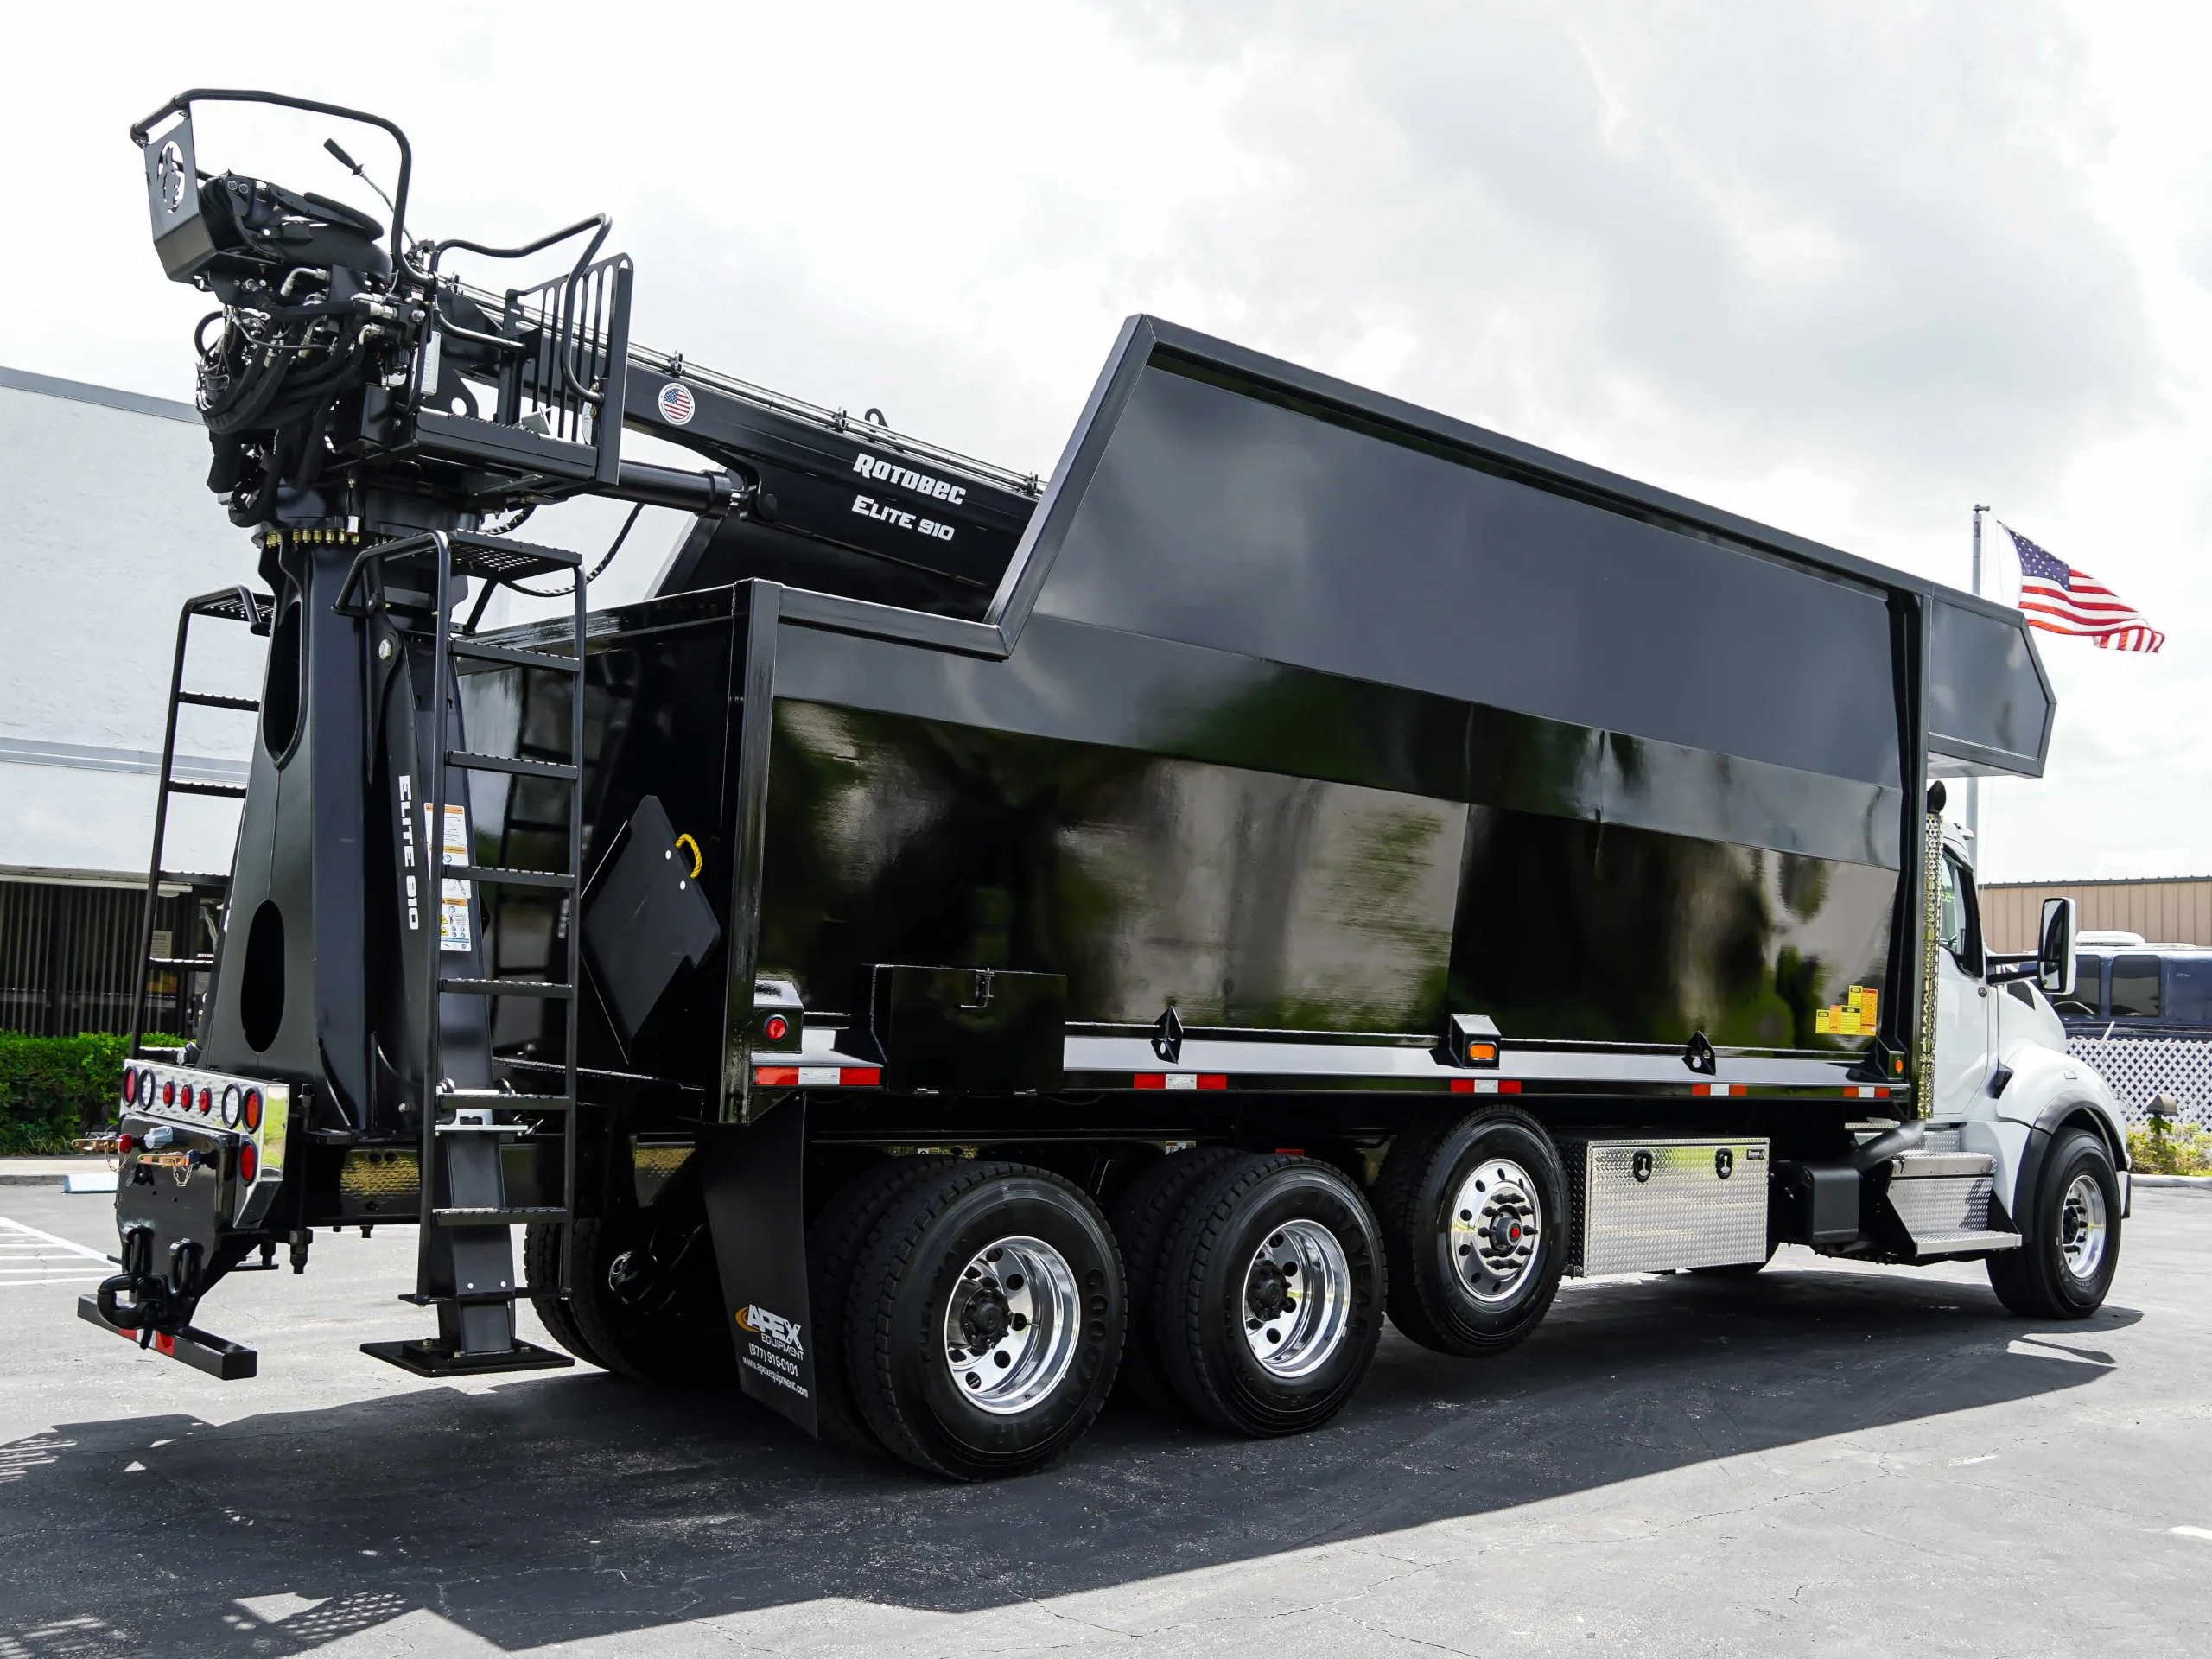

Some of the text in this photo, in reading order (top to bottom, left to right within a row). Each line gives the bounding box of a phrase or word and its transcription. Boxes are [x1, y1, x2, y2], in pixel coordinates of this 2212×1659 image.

[852, 494, 956, 542] ELITE 910
[398, 775, 419, 930] ELITE 910
[747, 1304, 804, 1351] APEX
[761, 1333, 804, 1361] EQUIPMENT
[742, 1356, 809, 1398] www.apexequipment.com
[748, 1343, 798, 1377] (877) 919-0101
